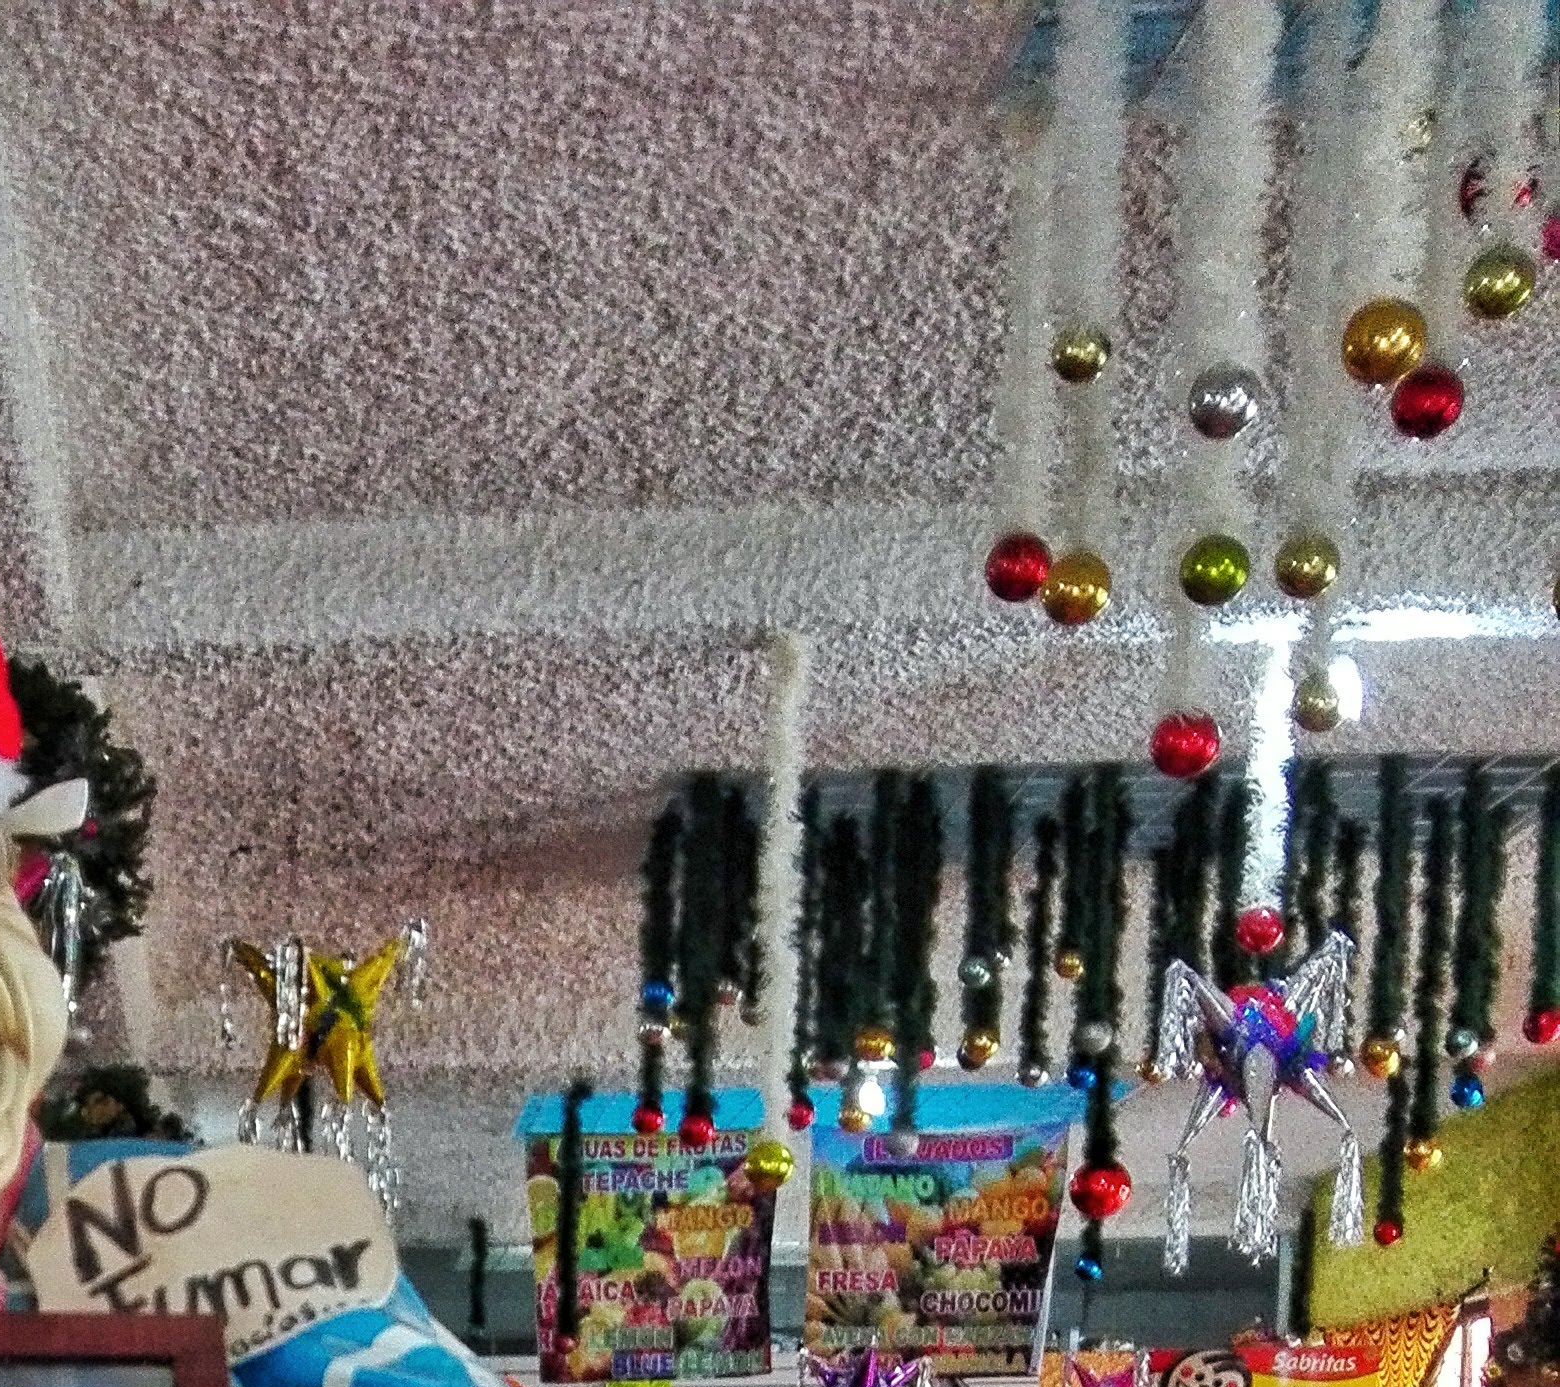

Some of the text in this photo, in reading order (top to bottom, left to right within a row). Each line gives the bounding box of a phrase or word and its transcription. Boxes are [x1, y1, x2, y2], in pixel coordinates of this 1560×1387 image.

[633, 1138, 659, 1157] DE
[872, 1140, 1004, 1162] LUADOS
[65, 1161, 210, 1284] NO
[537, 1279, 637, 1304] JAAICA
[816, 1269, 899, 1293] FRESA
[1272, 1350, 1357, 1373] Sabritas
